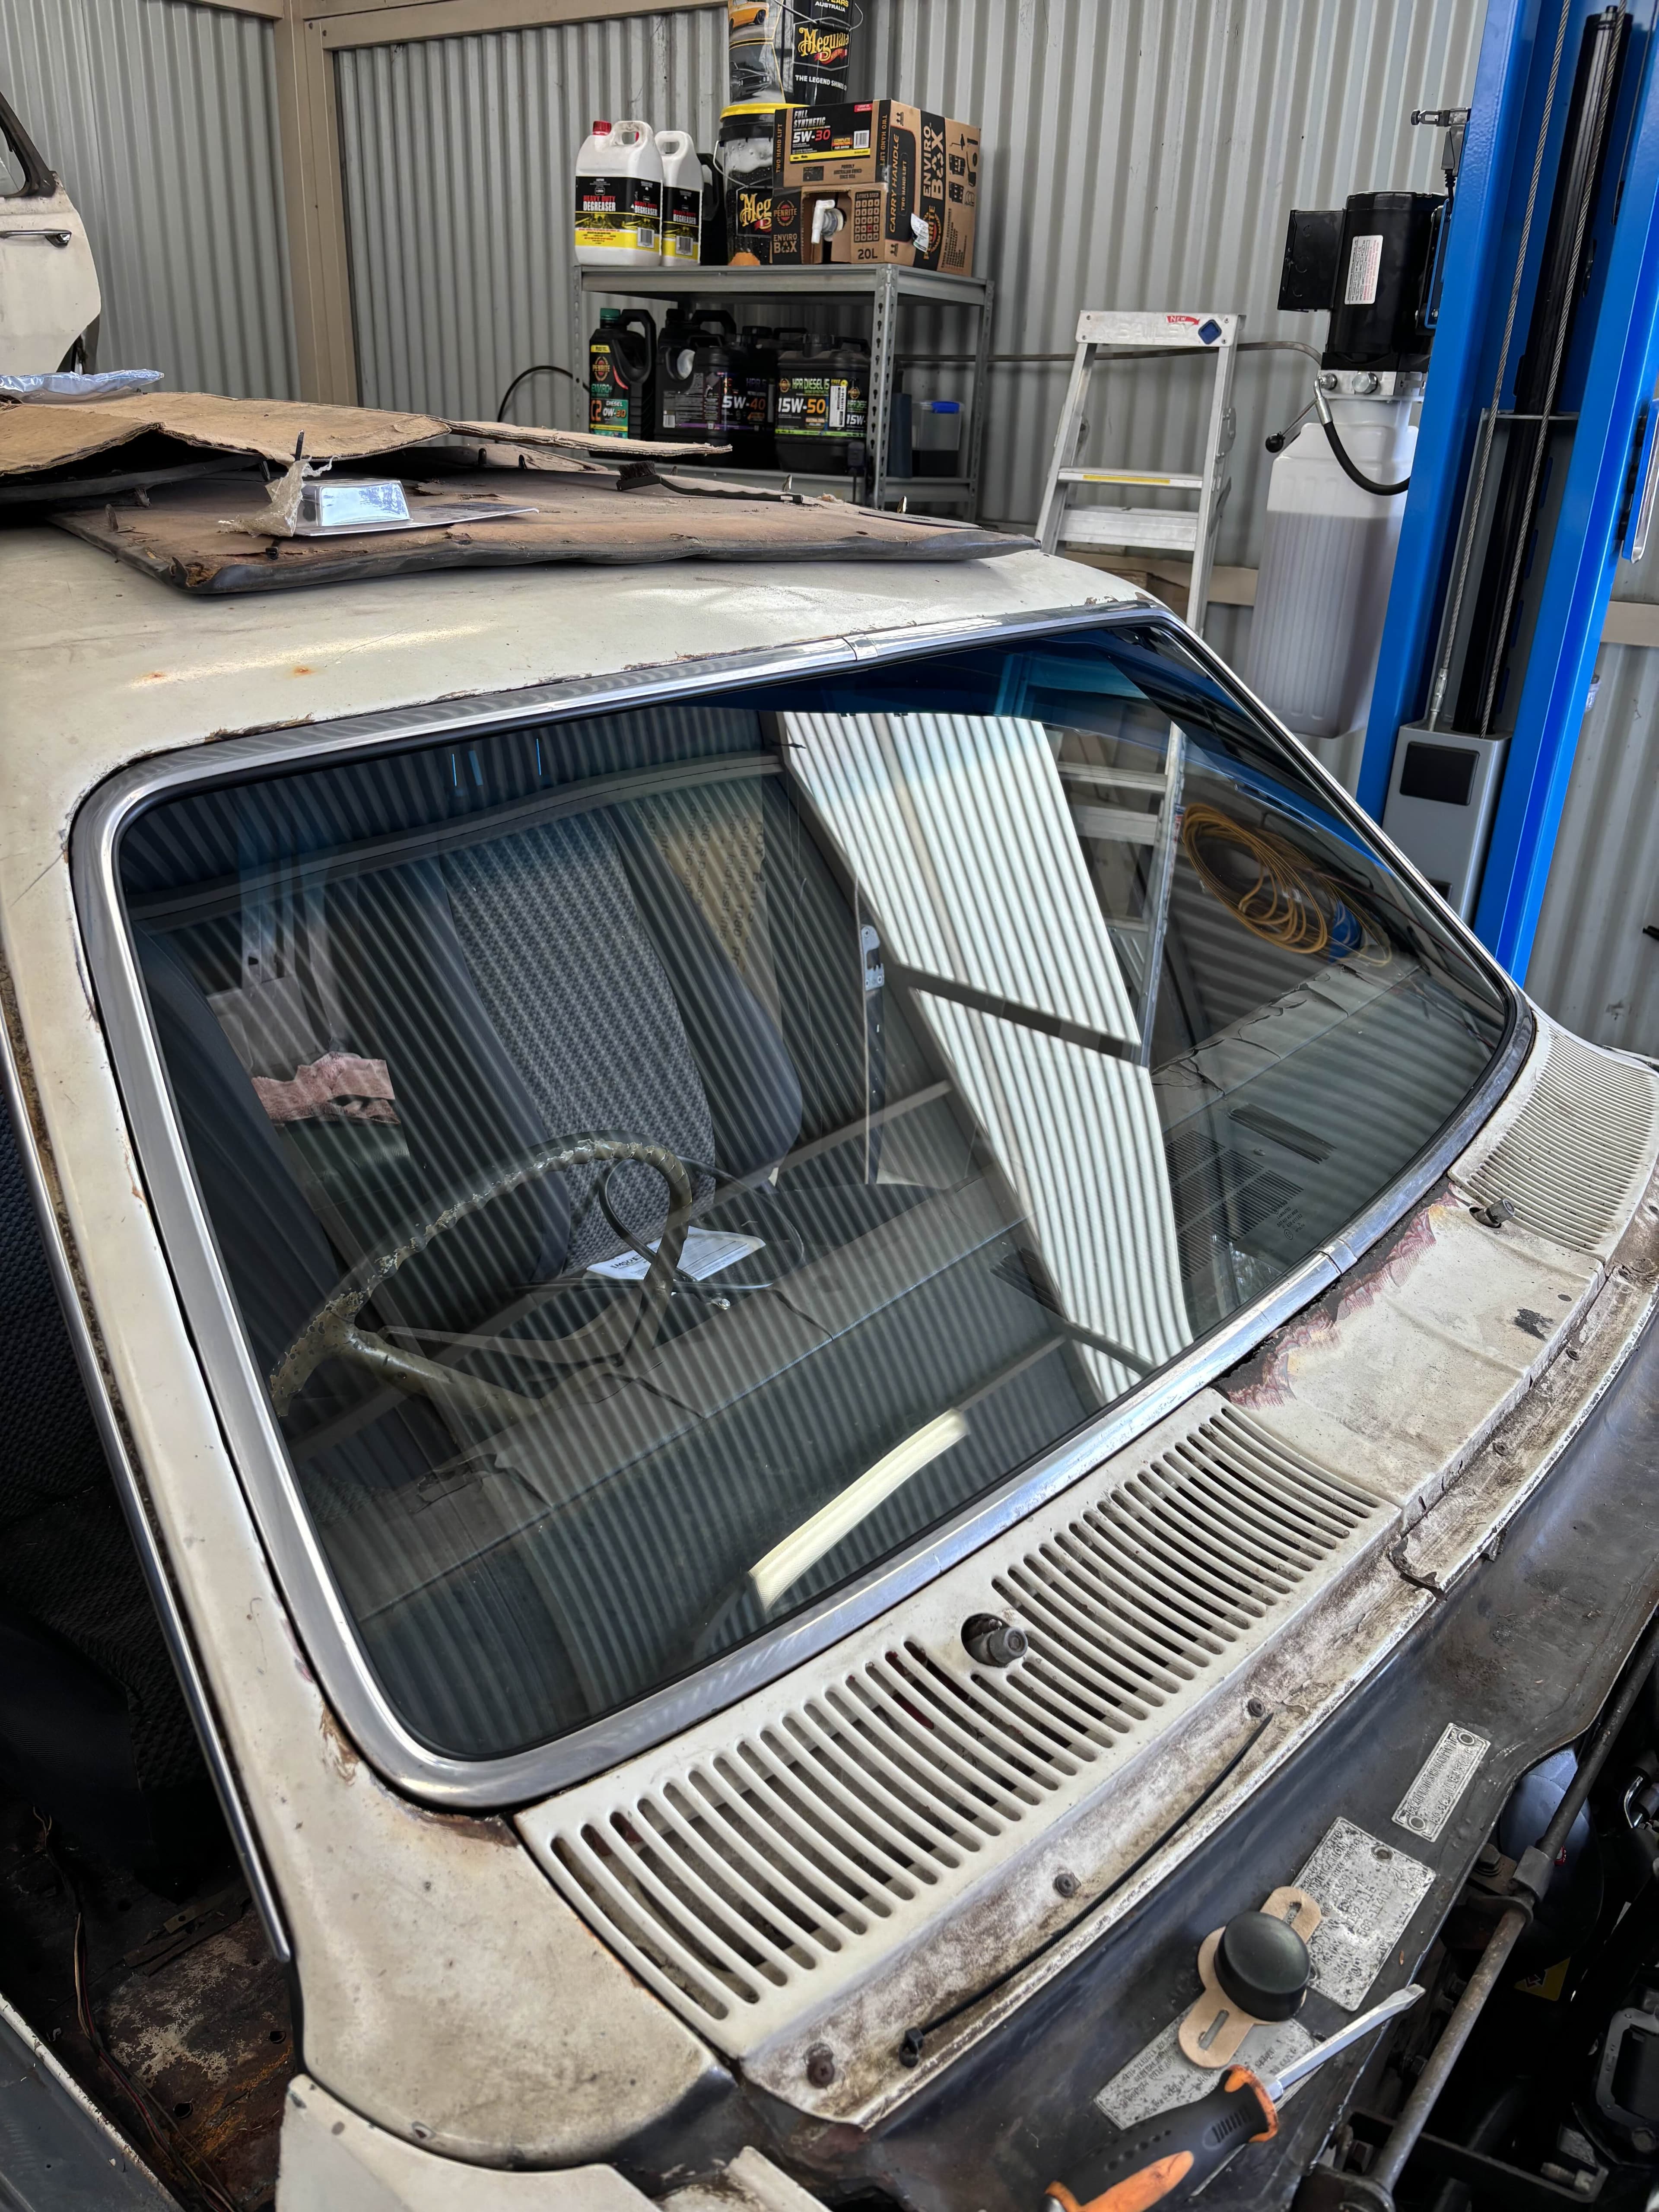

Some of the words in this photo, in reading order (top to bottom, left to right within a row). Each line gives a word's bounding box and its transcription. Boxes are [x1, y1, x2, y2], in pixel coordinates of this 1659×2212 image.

[815, 1, 845, 13] AUSTRALIA
[809, 76, 830, 86] LEGEND
[794, 110, 808, 119] FULL
[793, 117, 826, 128] SYNTHETIC
[793, 129, 831, 143] 5W-30
[891, 133, 899, 188] HANDLE
[923, 125, 931, 197] ENVIRO
[583, 201, 616, 212] DEGREASER
[634, 205, 658, 216] DEGREASER
[773, 208, 798, 217] PENRITE
[673, 214, 696, 225] DEGREASER
[773, 233, 798, 242] ENVIRO
[858, 248, 878, 260] 20L
[804, 378, 823, 390] DIESEL
[721, 395, 766, 410] 5W-40
[778, 397, 826, 414] 15W-50
[846, 414, 865, 426] 15W-
[1418, 1773, 1437, 1794] MOTORS
